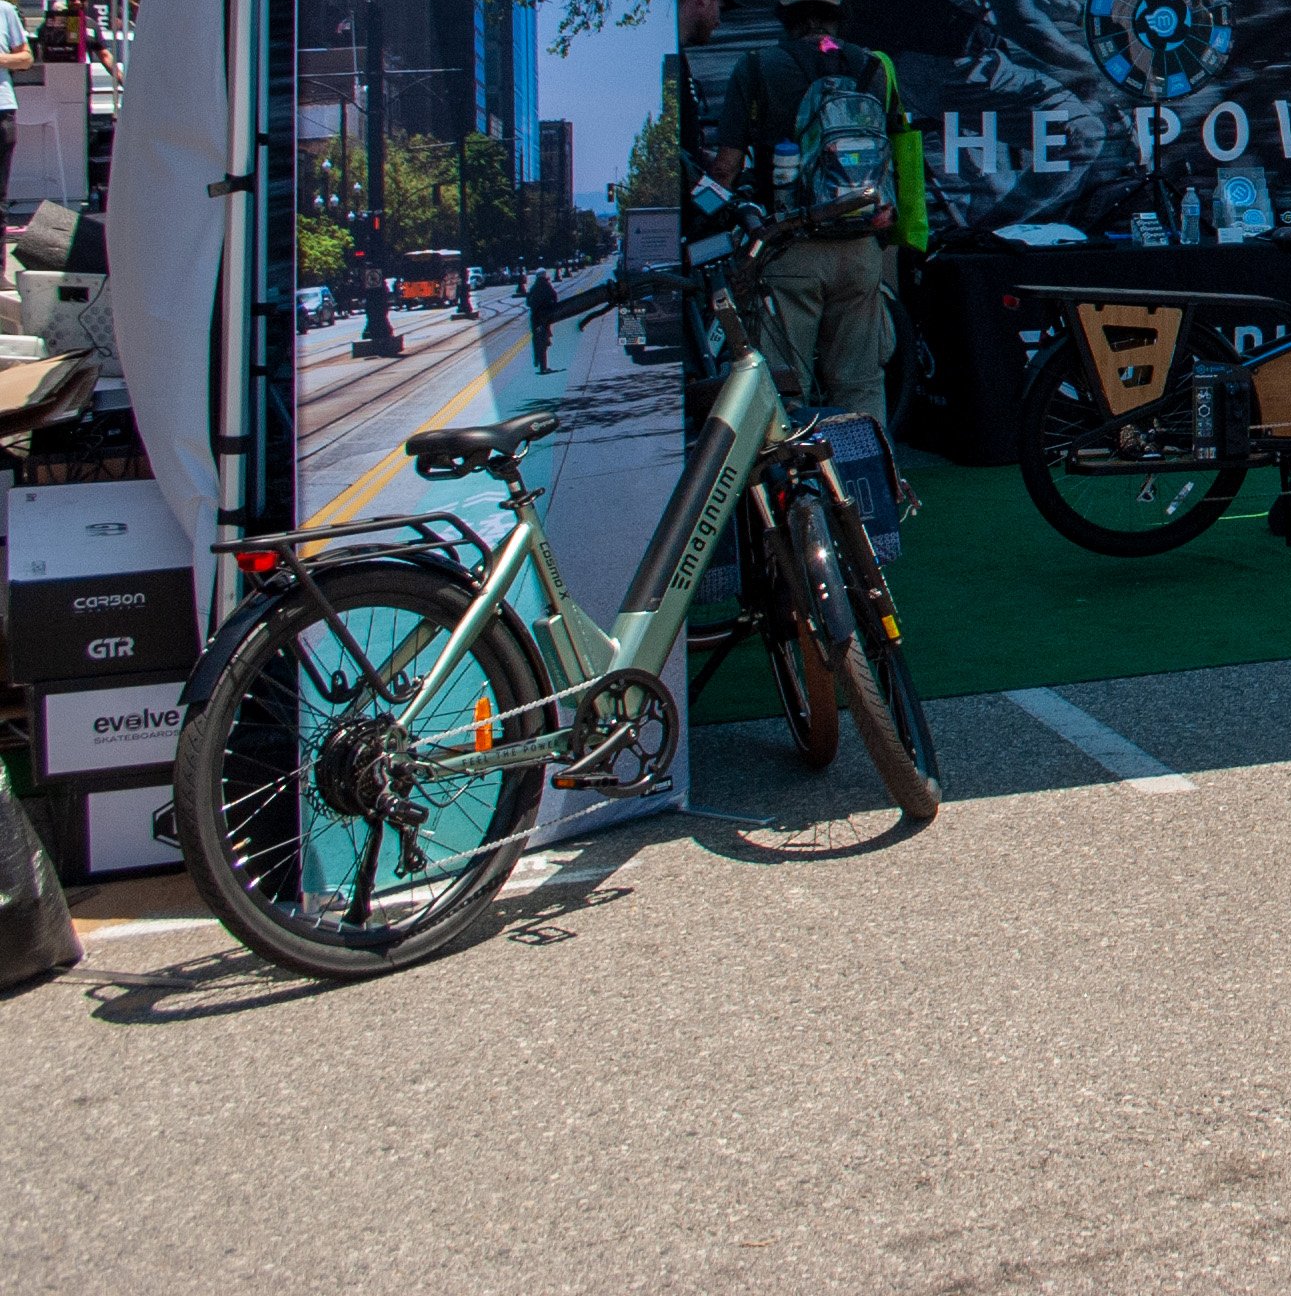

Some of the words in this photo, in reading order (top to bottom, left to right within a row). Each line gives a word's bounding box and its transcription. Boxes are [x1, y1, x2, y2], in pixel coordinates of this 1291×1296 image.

[87, 636, 135, 659] GTR
[93, 707, 180, 734] evolve
[93, 729, 181, 745] SKATEBOARDS
